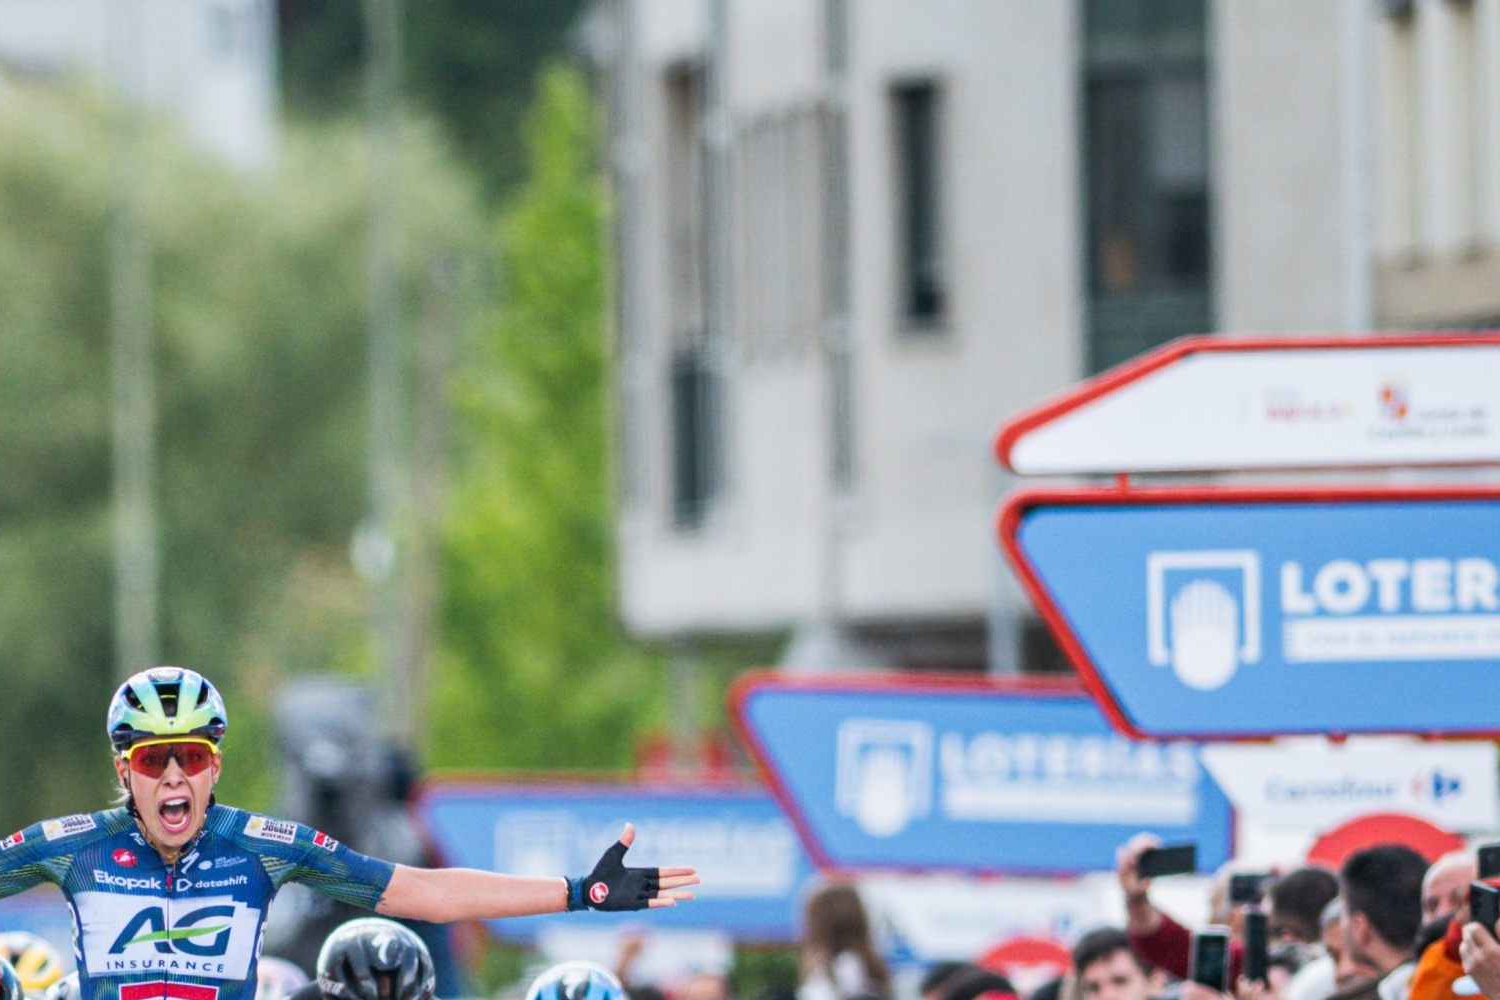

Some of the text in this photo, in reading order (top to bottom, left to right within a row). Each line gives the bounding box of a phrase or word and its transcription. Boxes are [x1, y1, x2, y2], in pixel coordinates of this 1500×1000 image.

[262, 824, 294, 836] JOGGER
[93, 869, 161, 890] Ekopak
[195, 875, 248, 888] datashift
[108, 905, 236, 957] AG
[106, 960, 225, 973] INSURANCE
